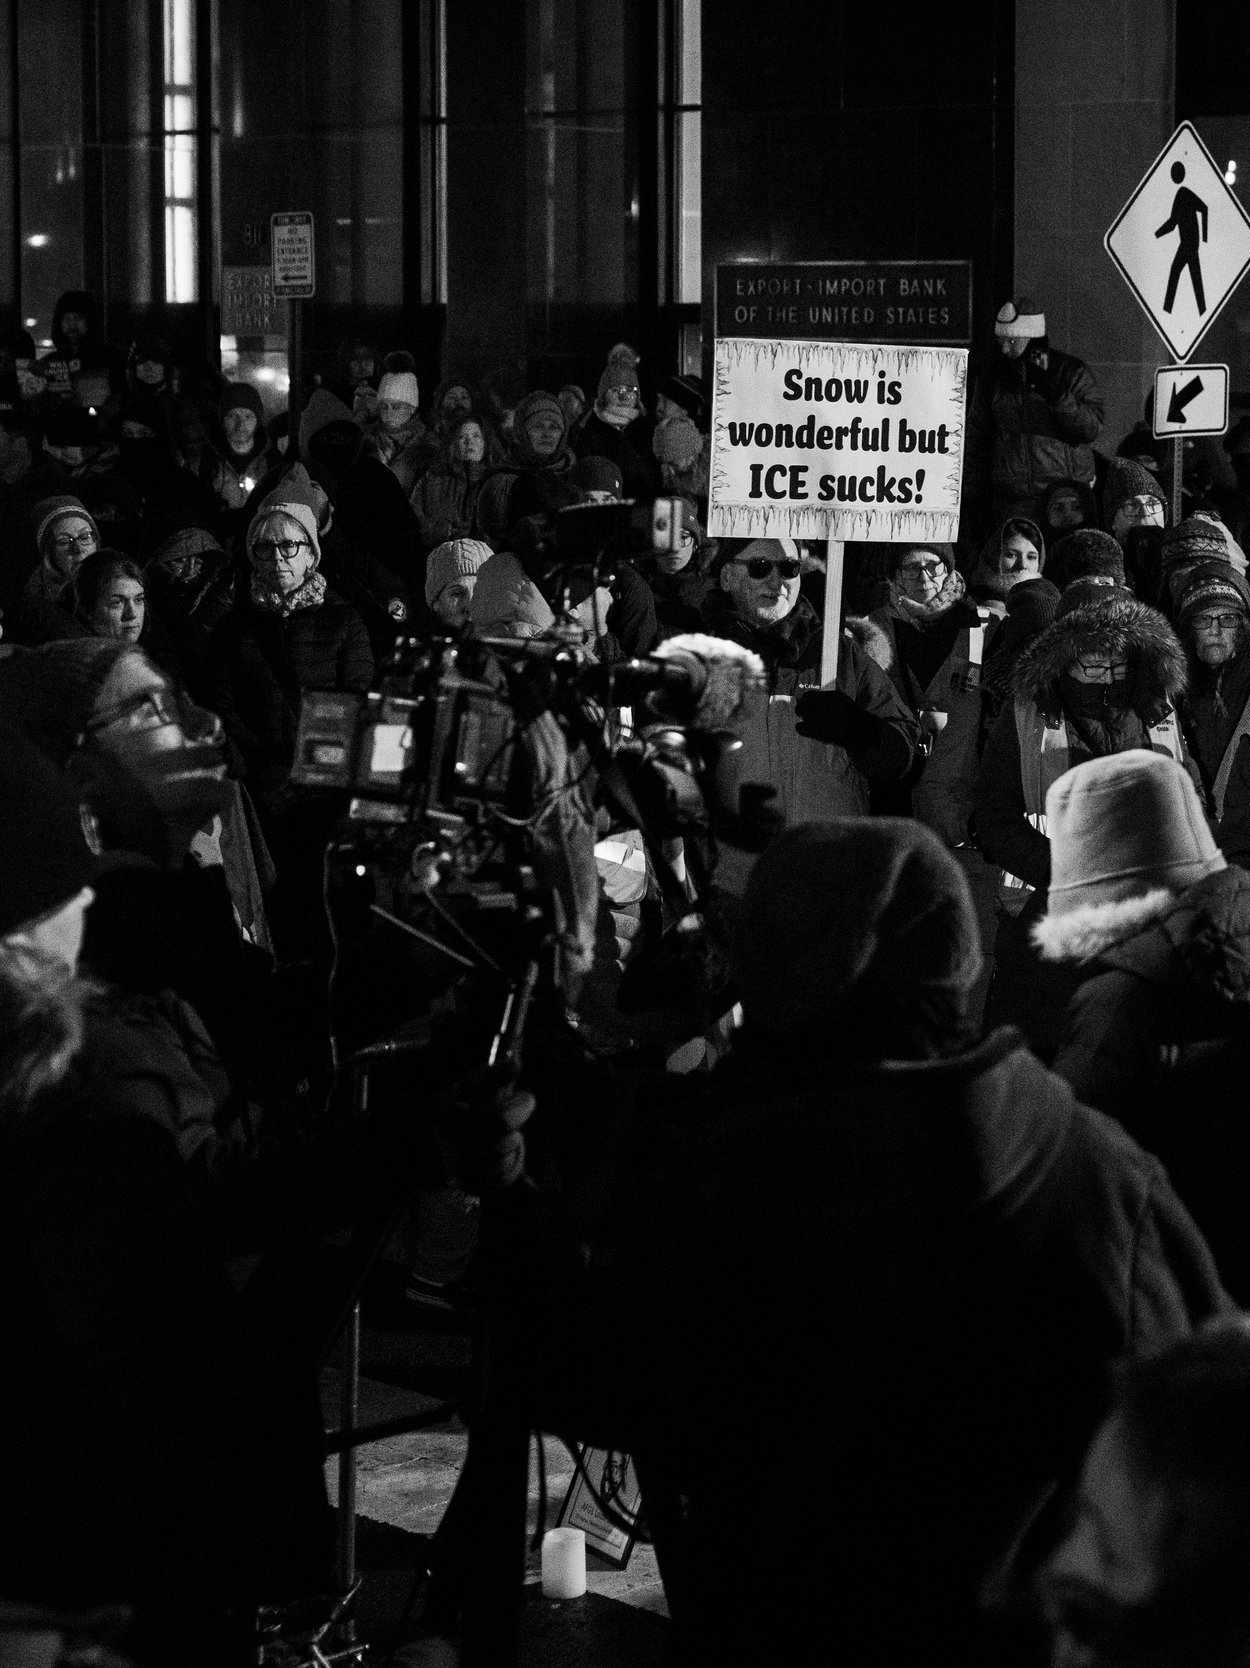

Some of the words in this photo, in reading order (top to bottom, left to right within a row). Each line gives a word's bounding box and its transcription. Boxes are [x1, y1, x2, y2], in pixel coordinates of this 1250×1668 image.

[899, 278, 947, 296] BANK
[236, 312, 271, 329] BANK
[734, 305, 758, 323] OF
[767, 306, 799, 324] THE
[809, 306, 875, 325] UNITED
[886, 306, 950, 325] STATES
[783, 368, 869, 403] Snow
[877, 370, 902, 405] is
[728, 414, 890, 452] wonderful
[898, 418, 950, 454] but
[749, 463, 809, 500] ICE
[817, 465, 926, 504] sucks!
